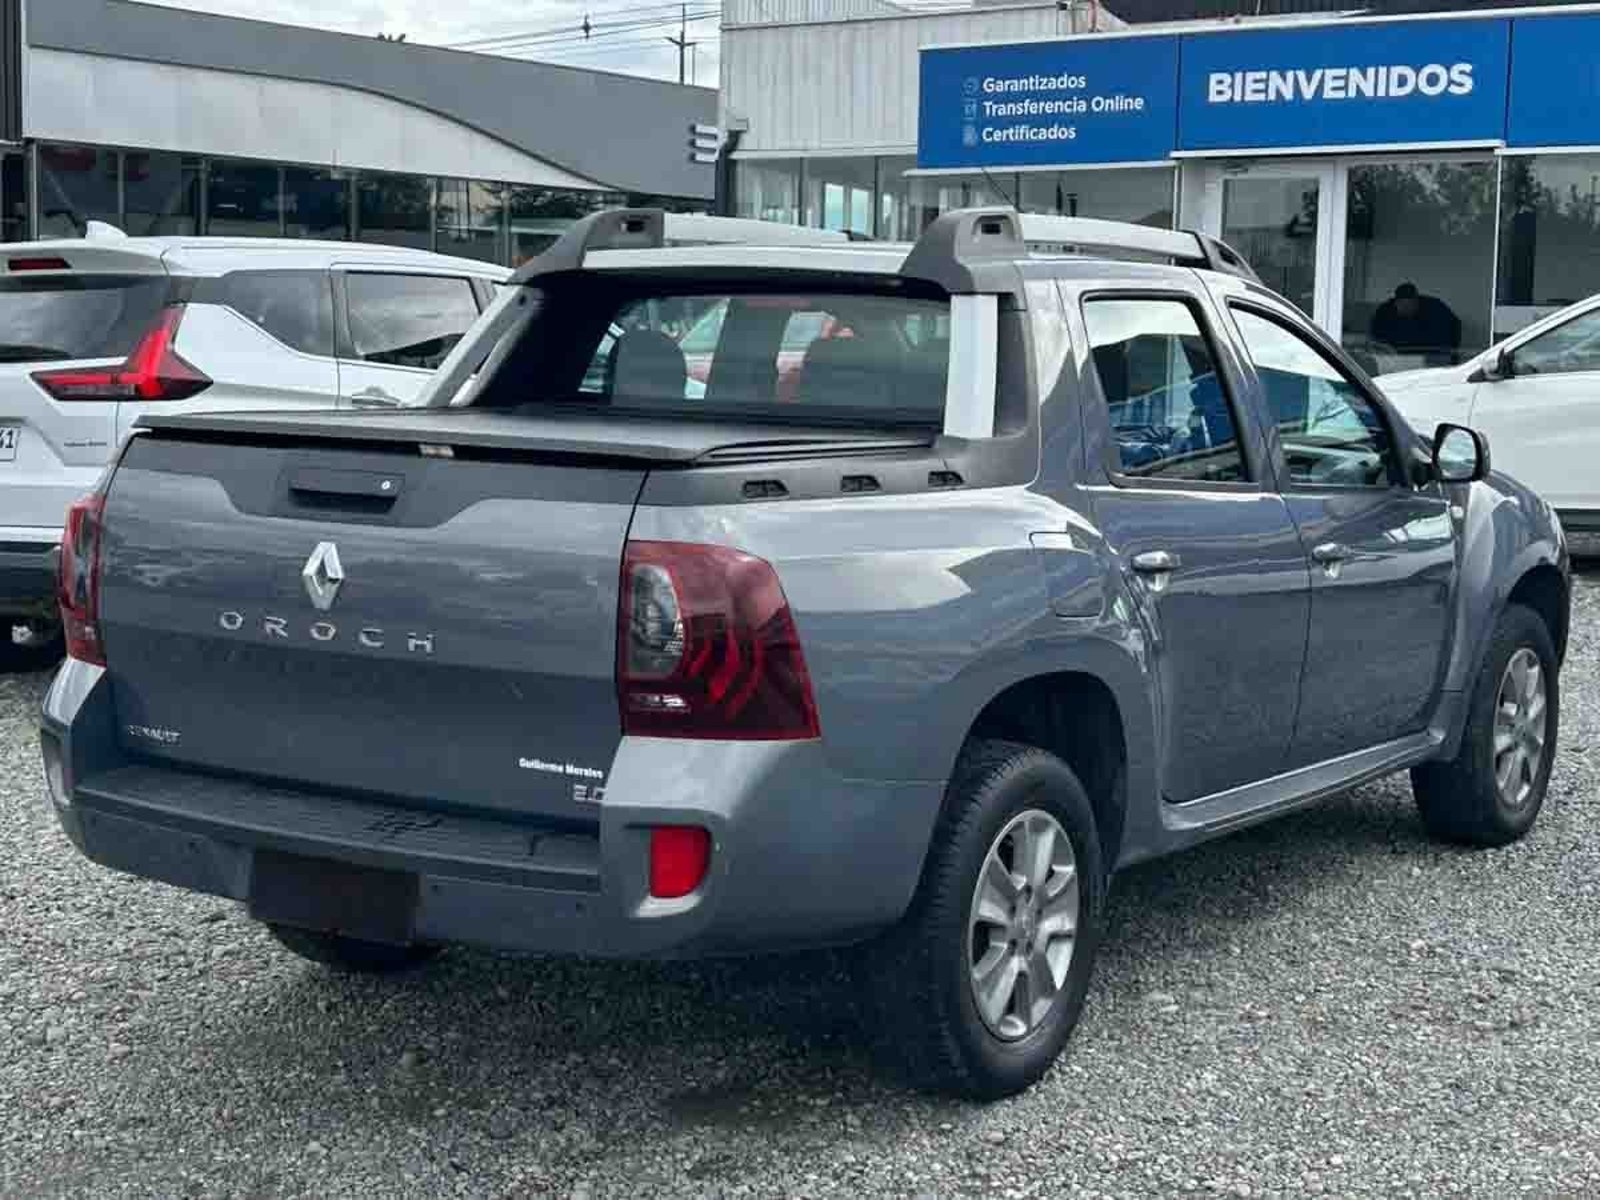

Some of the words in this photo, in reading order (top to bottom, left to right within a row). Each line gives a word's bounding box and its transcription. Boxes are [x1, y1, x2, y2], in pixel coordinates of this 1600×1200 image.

[982, 73, 1087, 93] Garantizados
[1208, 63, 1473, 103] BIENVENIDOS
[983, 97, 1087, 117] Transferencia
[1091, 95, 1145, 112] Online
[981, 123, 1077, 142] Certificados
[219, 611, 435, 653] OROCH
